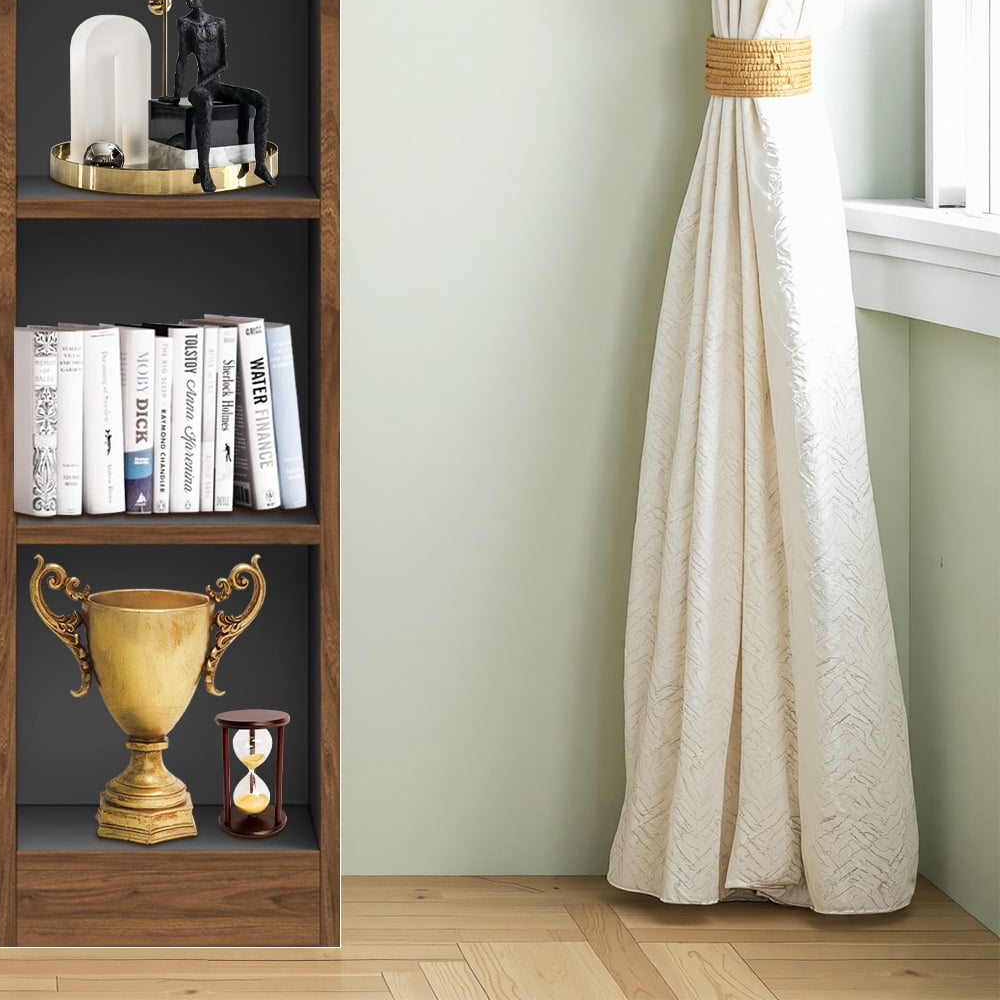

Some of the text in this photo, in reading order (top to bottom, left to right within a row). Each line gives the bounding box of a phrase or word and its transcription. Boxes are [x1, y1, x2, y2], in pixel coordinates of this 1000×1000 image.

[161, 343, 169, 357] THE
[136, 351, 150, 392] MOBY
[222, 359, 236, 397] Sherlock
[135, 398, 149, 444] DICK
[180, 333, 198, 493] TOLSTOY Anna Karenina
[221, 400, 235, 432] Holmes
[249, 356, 274, 469] WATER FINANCE
